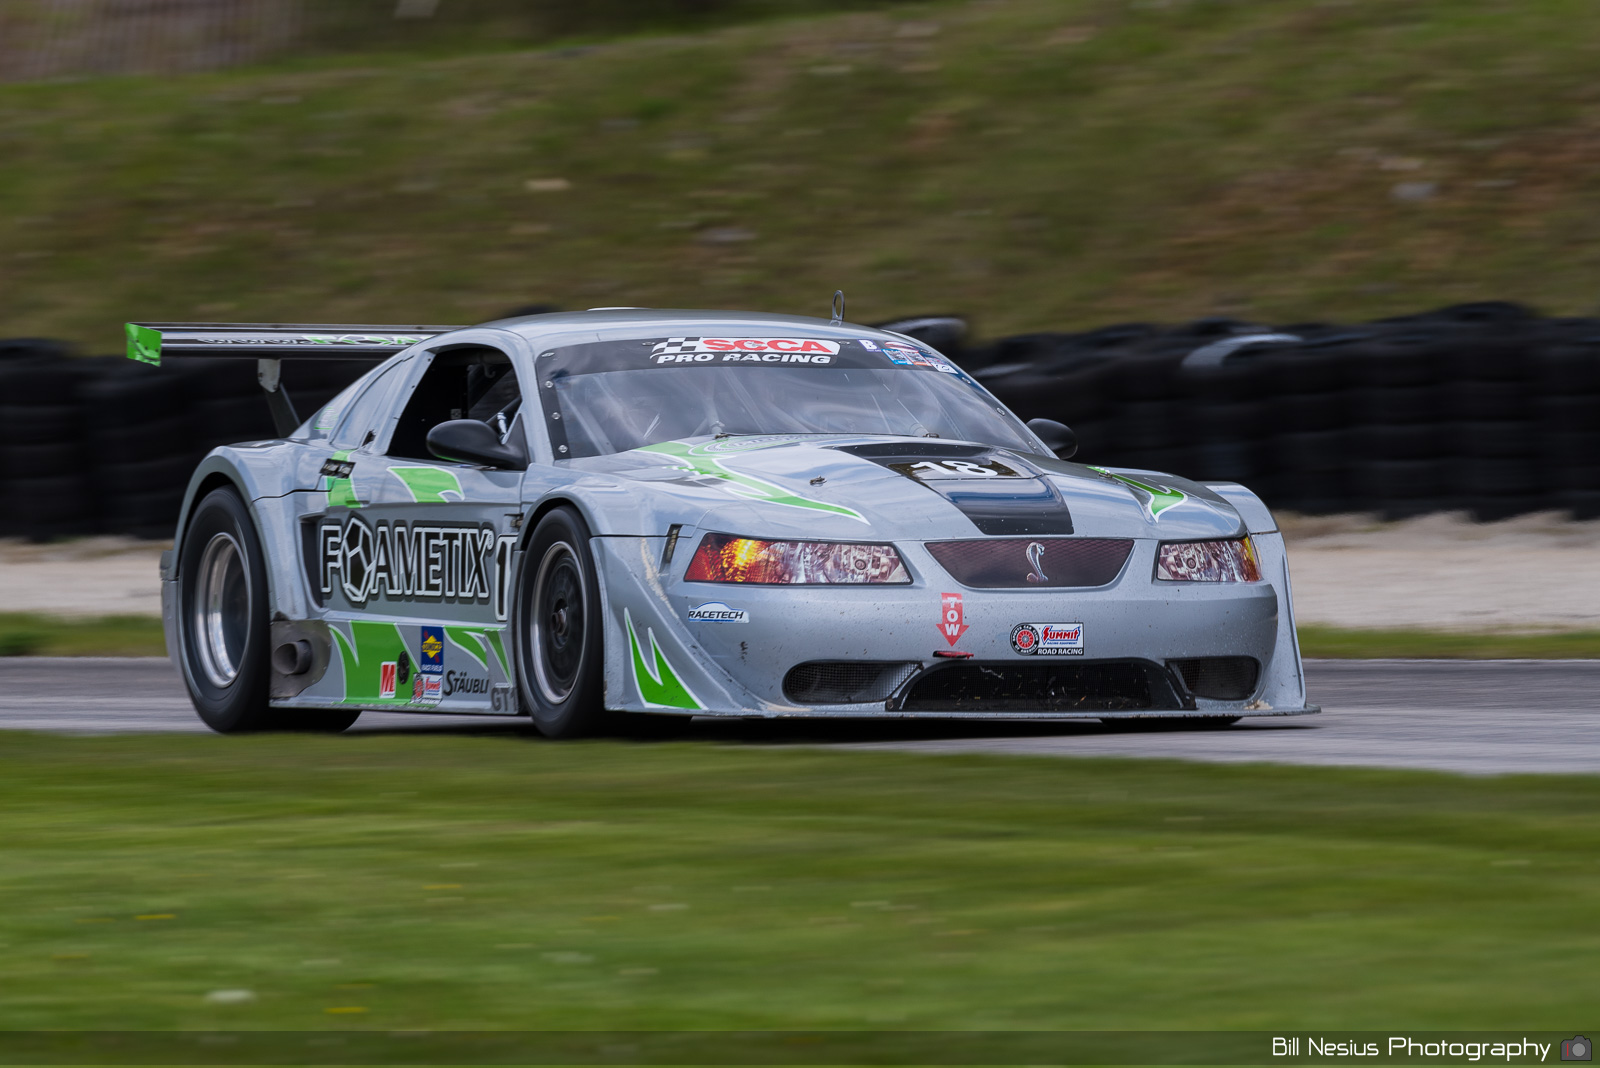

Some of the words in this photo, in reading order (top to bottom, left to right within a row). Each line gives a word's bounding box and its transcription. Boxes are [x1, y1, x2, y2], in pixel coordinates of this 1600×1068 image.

[702, 339, 833, 353] SCCA
[656, 353, 714, 364] PRO
[722, 353, 832, 364] RACING
[910, 459, 999, 477] 18
[495, 534, 519, 622] 1
[687, 610, 744, 619] RACETECH
[945, 596, 960, 636] TOW
